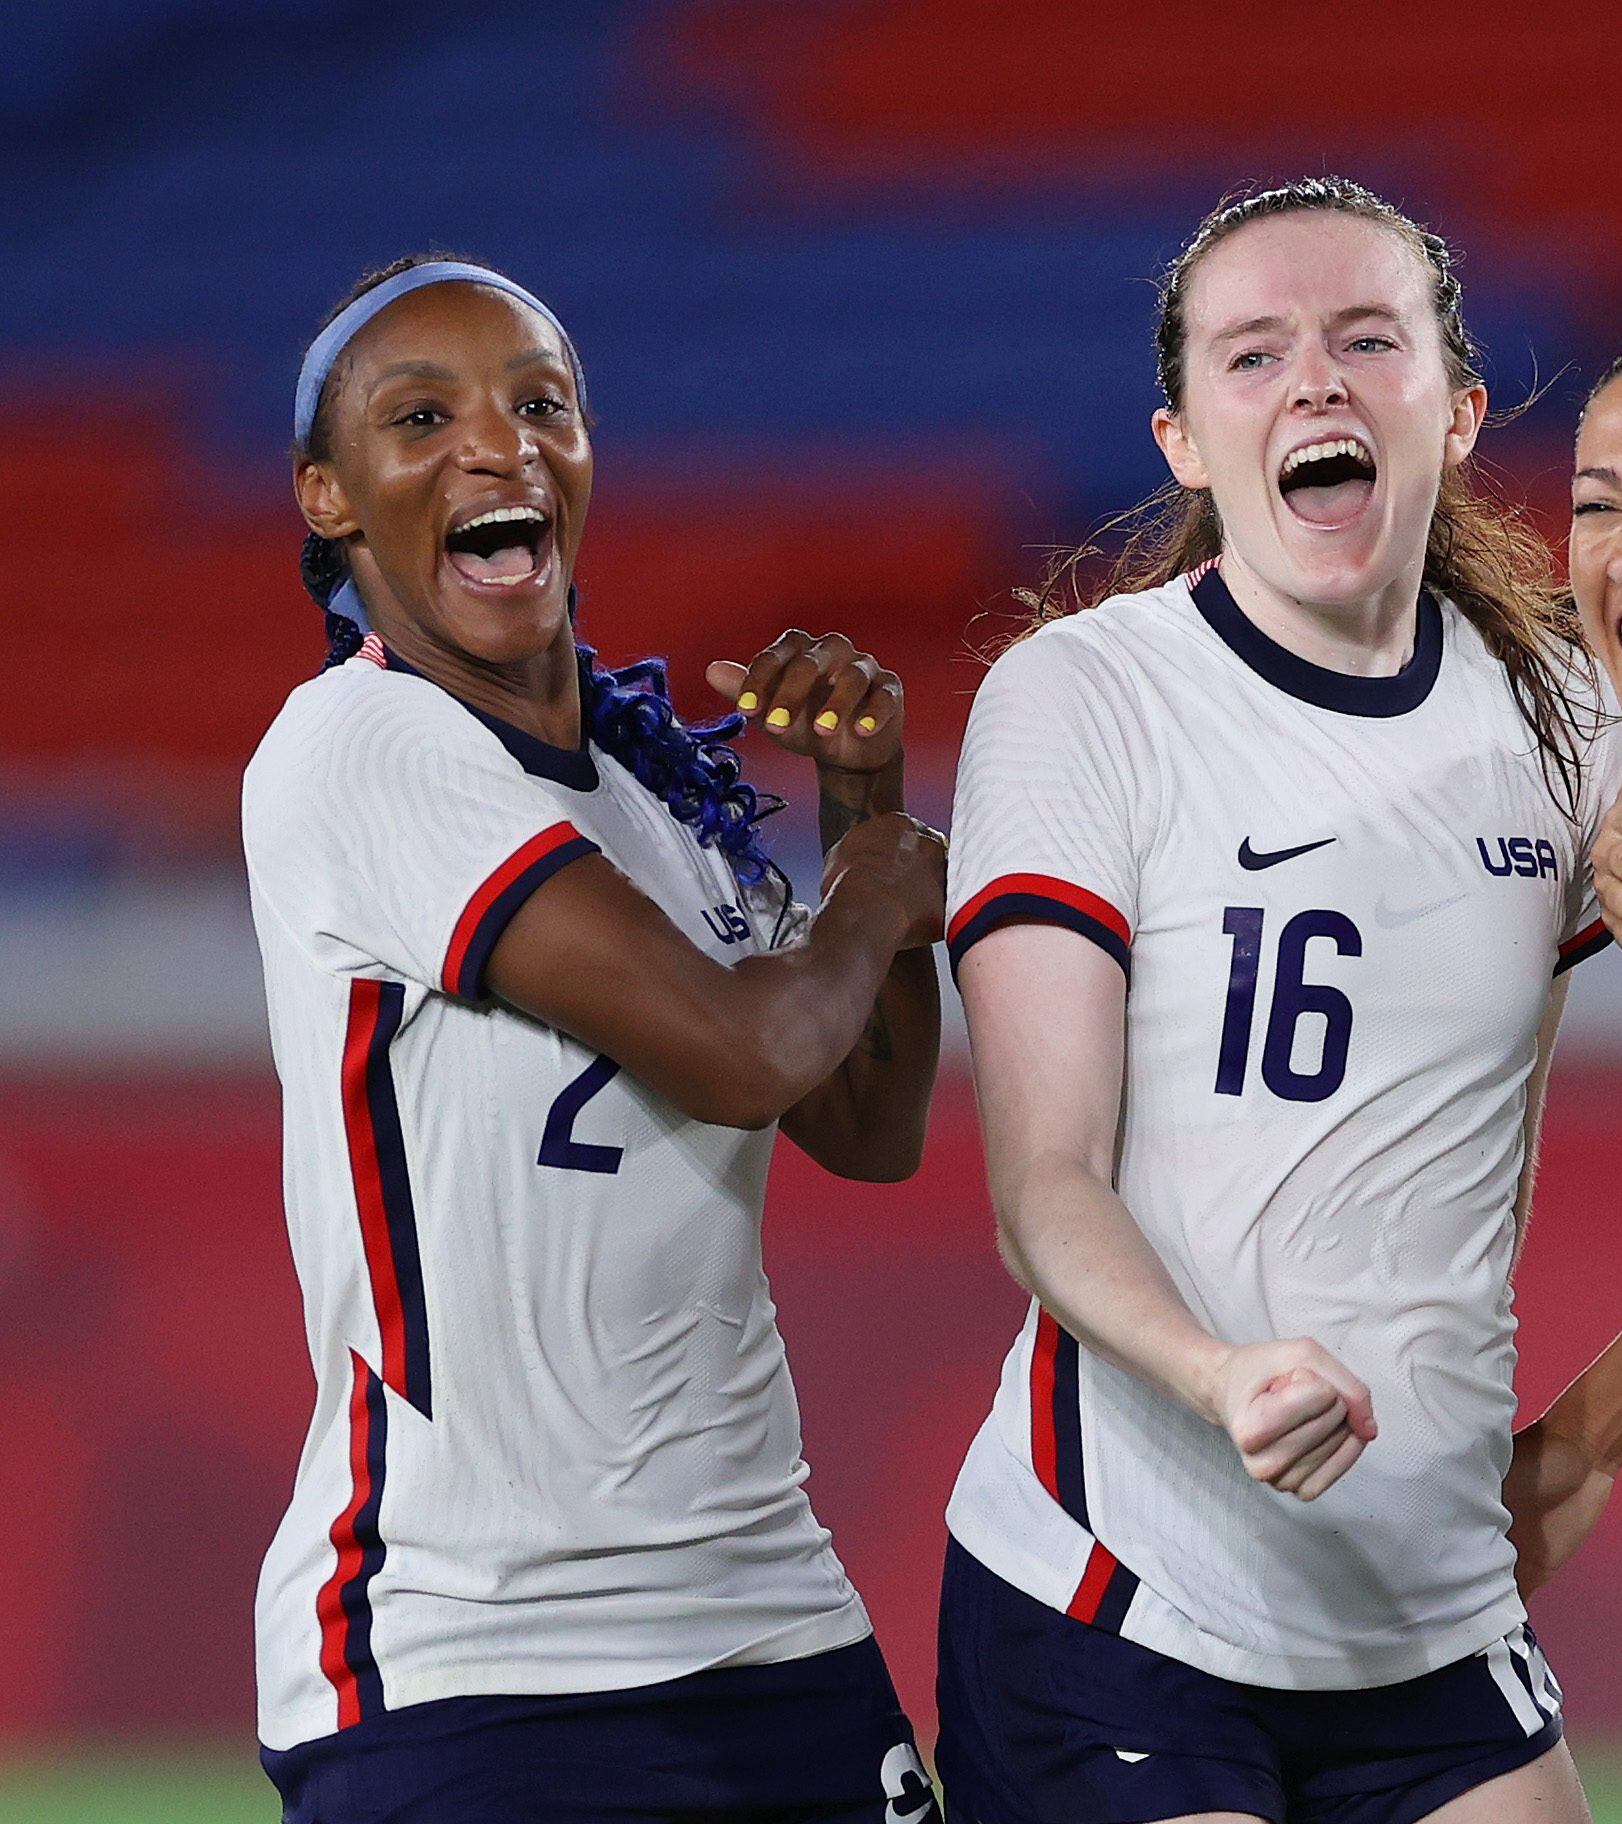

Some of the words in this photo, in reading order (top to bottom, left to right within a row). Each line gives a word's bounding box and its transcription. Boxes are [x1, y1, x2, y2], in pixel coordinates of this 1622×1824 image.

[1476, 837, 1558, 882] USA
[700, 896, 752, 945] US
[1214, 906, 1363, 1103] 16
